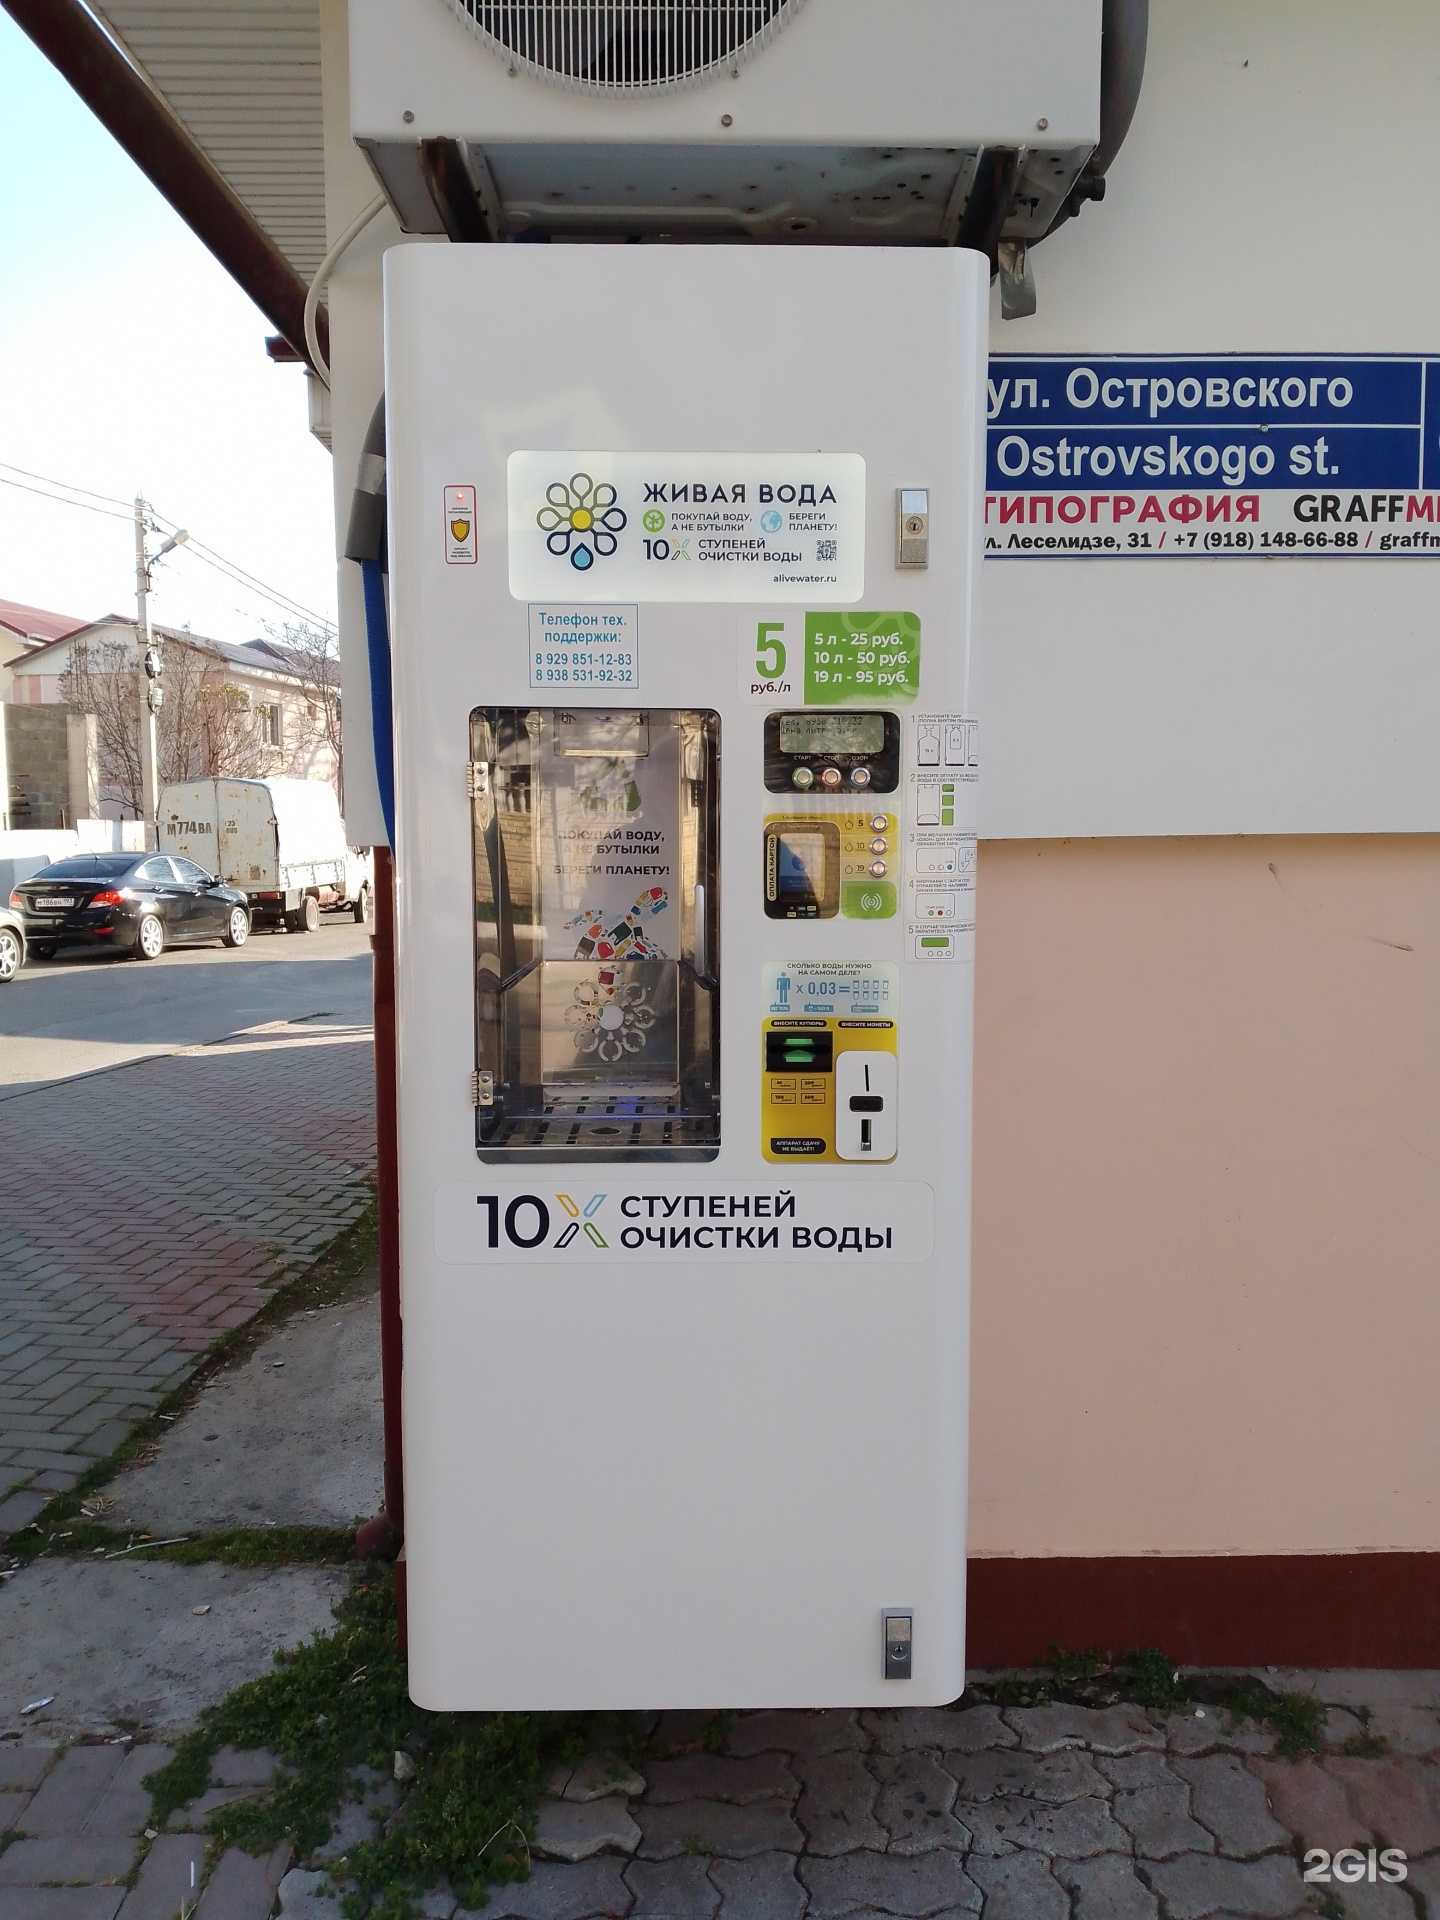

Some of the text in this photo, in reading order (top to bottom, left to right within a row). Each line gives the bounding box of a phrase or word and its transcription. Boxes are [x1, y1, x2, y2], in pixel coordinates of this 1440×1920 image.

[988, 368, 1354, 419] ул. Островского
[997, 435, 1339, 486] Ostrovskogo st.
[643, 484, 837, 507] ЖИВАЯ ВОДА
[671, 511, 752, 523] ПОКУПАЙ ВОДУ,
[789, 512, 826, 521] БЕРЕГИ
[671, 523, 744, 532] А НЕ БУТЫЛКИ
[789, 523, 838, 531] ПЛАНЕТУ!
[698, 537, 766, 549] СТУПЕНЕЙ
[984, 535, 1002, 549] л.
[1008, 532, 1121, 552] Леселидзе,
[1127, 533, 1152, 548] 31
[1173, 533, 1198, 548] +7
[1204, 532, 1254, 551] (918)
[1260, 532, 1359, 548] 148-66-88
[698, 551, 802, 563] ОЧИСТКИ ВОДЫ
[773, 574, 837, 583] alivewater.ru
[538, 611, 628, 628] Телефон тех.
[544, 631, 622, 646] поддержки:
[814, 633, 823, 645] 5
[827, 635, 837, 645] л
[850, 633, 869, 645] 25
[872, 632, 903, 648] руб.
[755, 622, 787, 679] 5
[536, 653, 633, 666] 8 929 851-12-83
[814, 651, 831, 664] 10
[834, 654, 844, 664] л
[856, 651, 877, 664] 50
[880, 651, 911, 668] руб.
[536, 669, 633, 682] 8 938 531-92-32
[814, 670, 831, 683] 19
[834, 673, 844, 683] л
[855, 670, 875, 683] 95
[878, 670, 909, 686] руб.
[750, 680, 791, 696] руб./л
[857, 819, 864, 827] 5
[626, 830, 665, 842] ВОДУ,
[597, 845, 660, 855] БУТЫЛКИ
[606, 865, 670, 875] ПЛАНЕТУ!
[620, 1190, 796, 1219] СТУПЕНЕЙ
[620, 1226, 893, 1252] ОЧИСТКИ ВОДЫ
